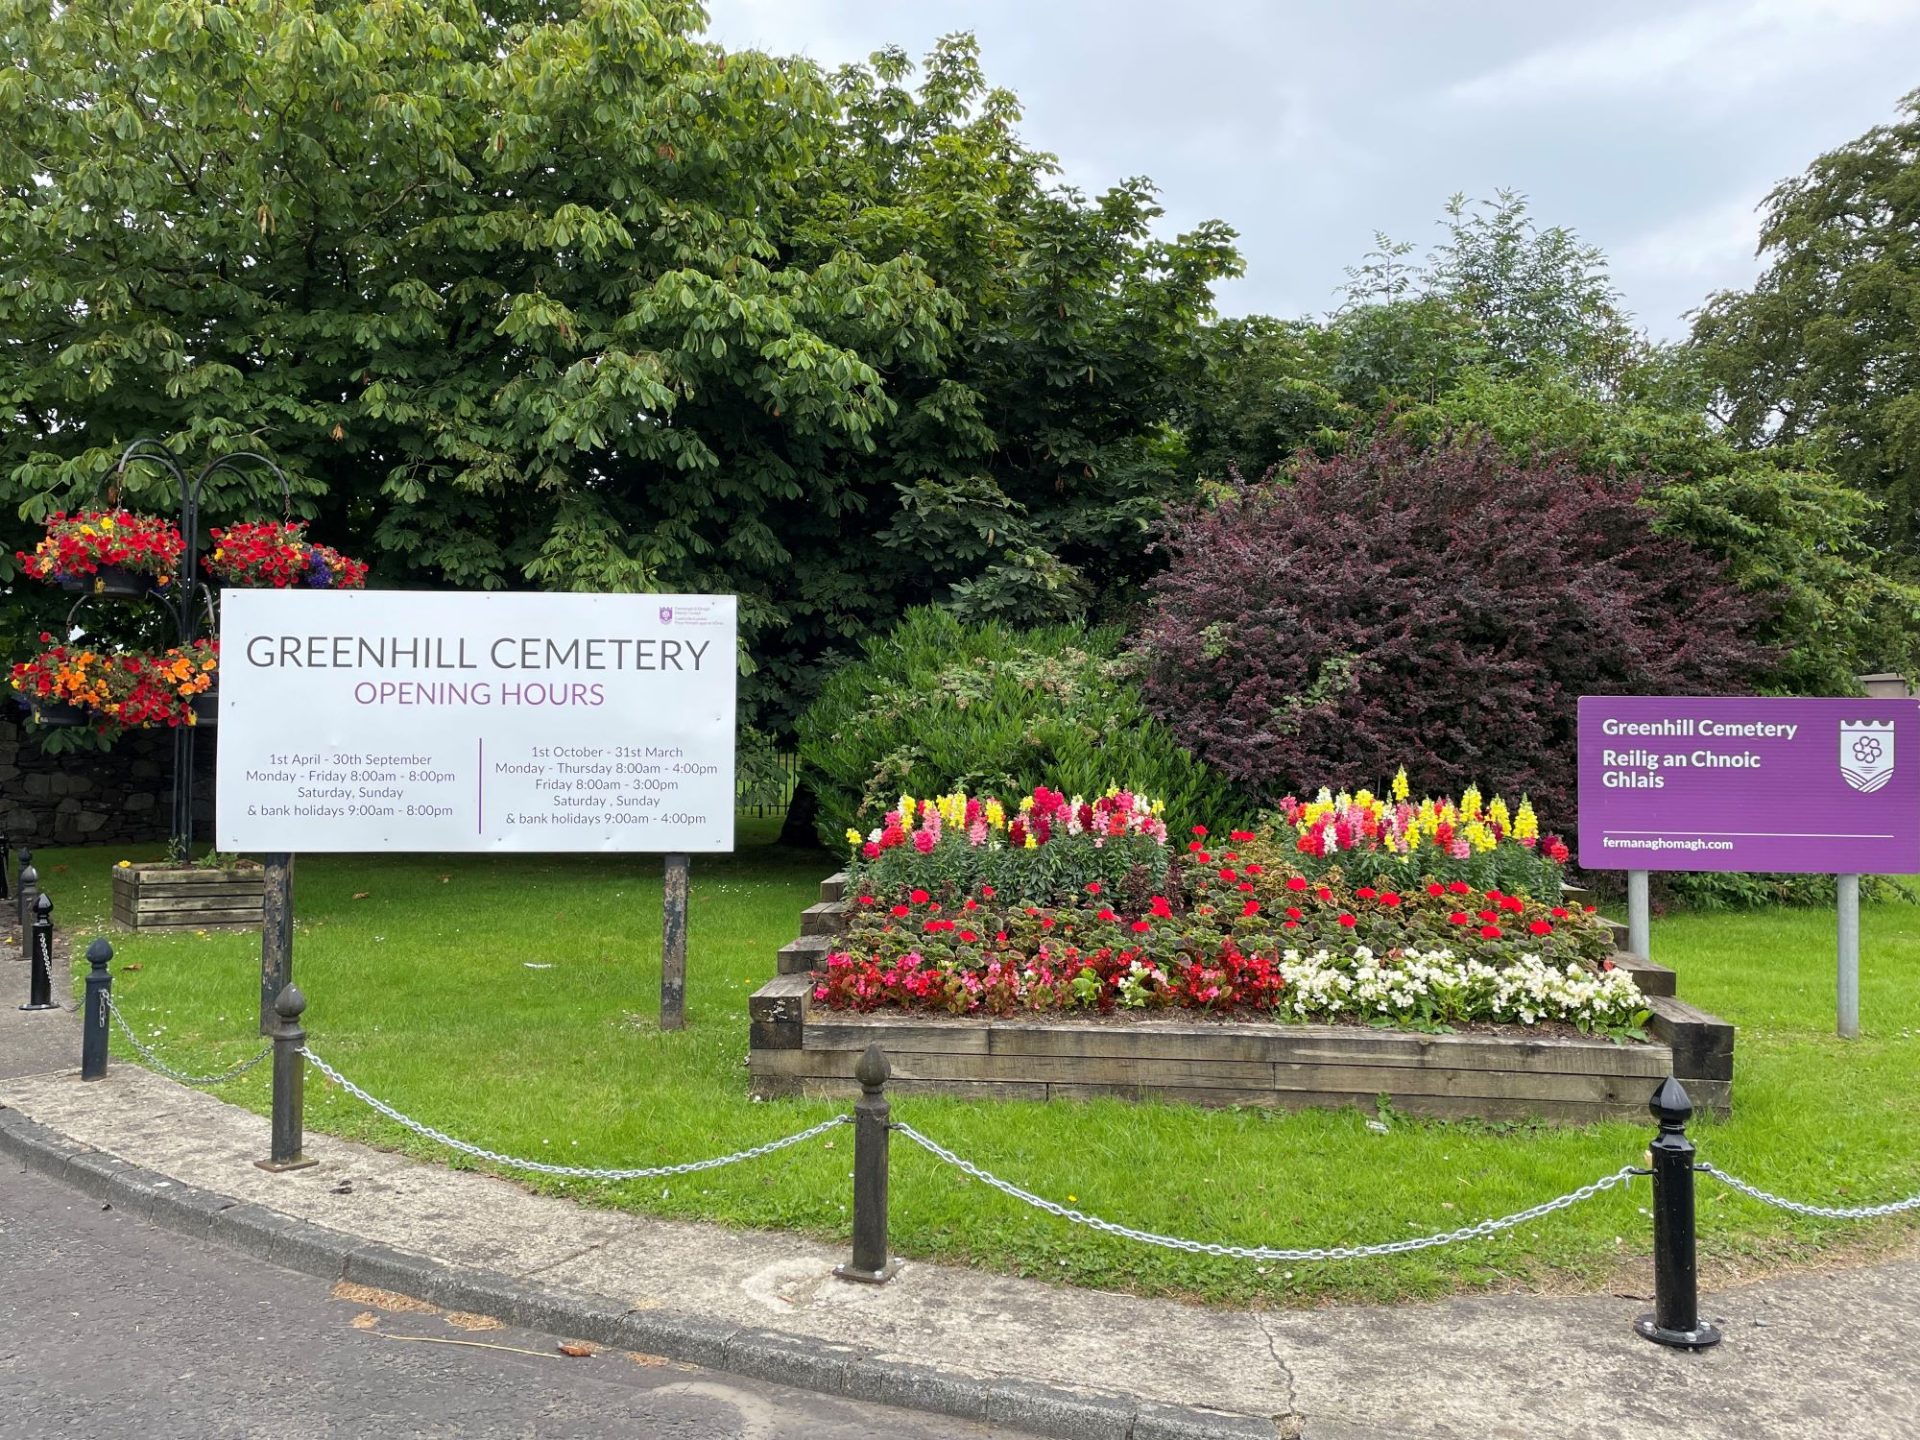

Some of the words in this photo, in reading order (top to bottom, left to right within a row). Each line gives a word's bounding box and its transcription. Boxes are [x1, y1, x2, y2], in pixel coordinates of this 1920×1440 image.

[244, 634, 478, 669] GREENHILL
[490, 637, 711, 672] CEMETERY
[354, 681, 491, 706] OPENING
[501, 682, 605, 707] HOURS
[1603, 718, 1694, 736] Greenhill
[1697, 719, 1798, 740] Cemetery
[531, 746, 550, 758] 1st
[553, 746, 604, 758] October
[615, 746, 641, 758] 31st
[645, 746, 683, 758] March
[269, 753, 288, 765] 1st
[291, 753, 321, 768] April
[332, 753, 362, 765] 30th
[365, 753, 433, 768] September
[1603, 750, 1659, 770] Reilig
[1663, 754, 1687, 767] an
[1691, 750, 1761, 768] Chnoic
[245, 769, 297, 784] Monday
[308, 770, 347, 784] Friday
[350, 770, 397, 782] 8:00am
[408, 770, 456, 784] 8:00pm
[495, 762, 545, 777] Monday
[556, 762, 613, 777] Thursday
[615, 762, 661, 774] 8:00am
[672, 762, 718, 777] 4:00pm
[535, 778, 573, 792] Friday
[576, 778, 621, 790] 8:00am
[632, 778, 679, 792] 3:00pm
[1603, 771, 1665, 788] Ghlais
[297, 786, 356, 801] Saturday,
[358, 786, 404, 801] Sunday
[616, 794, 661, 809] Sunday
[247, 804, 257, 816] &
[261, 804, 291, 816] bank
[294, 804, 345, 819] holidays
[347, 804, 395, 816] 9:00am
[406, 804, 453, 819] 8:00pm
[505, 812, 516, 825] &
[519, 812, 548, 825] bank
[551, 812, 601, 826] holidays
[604, 812, 649, 825] 9:00am
[660, 812, 707, 826] 4:00pm
[1602, 836, 1734, 851] fermanaghomagh.com
